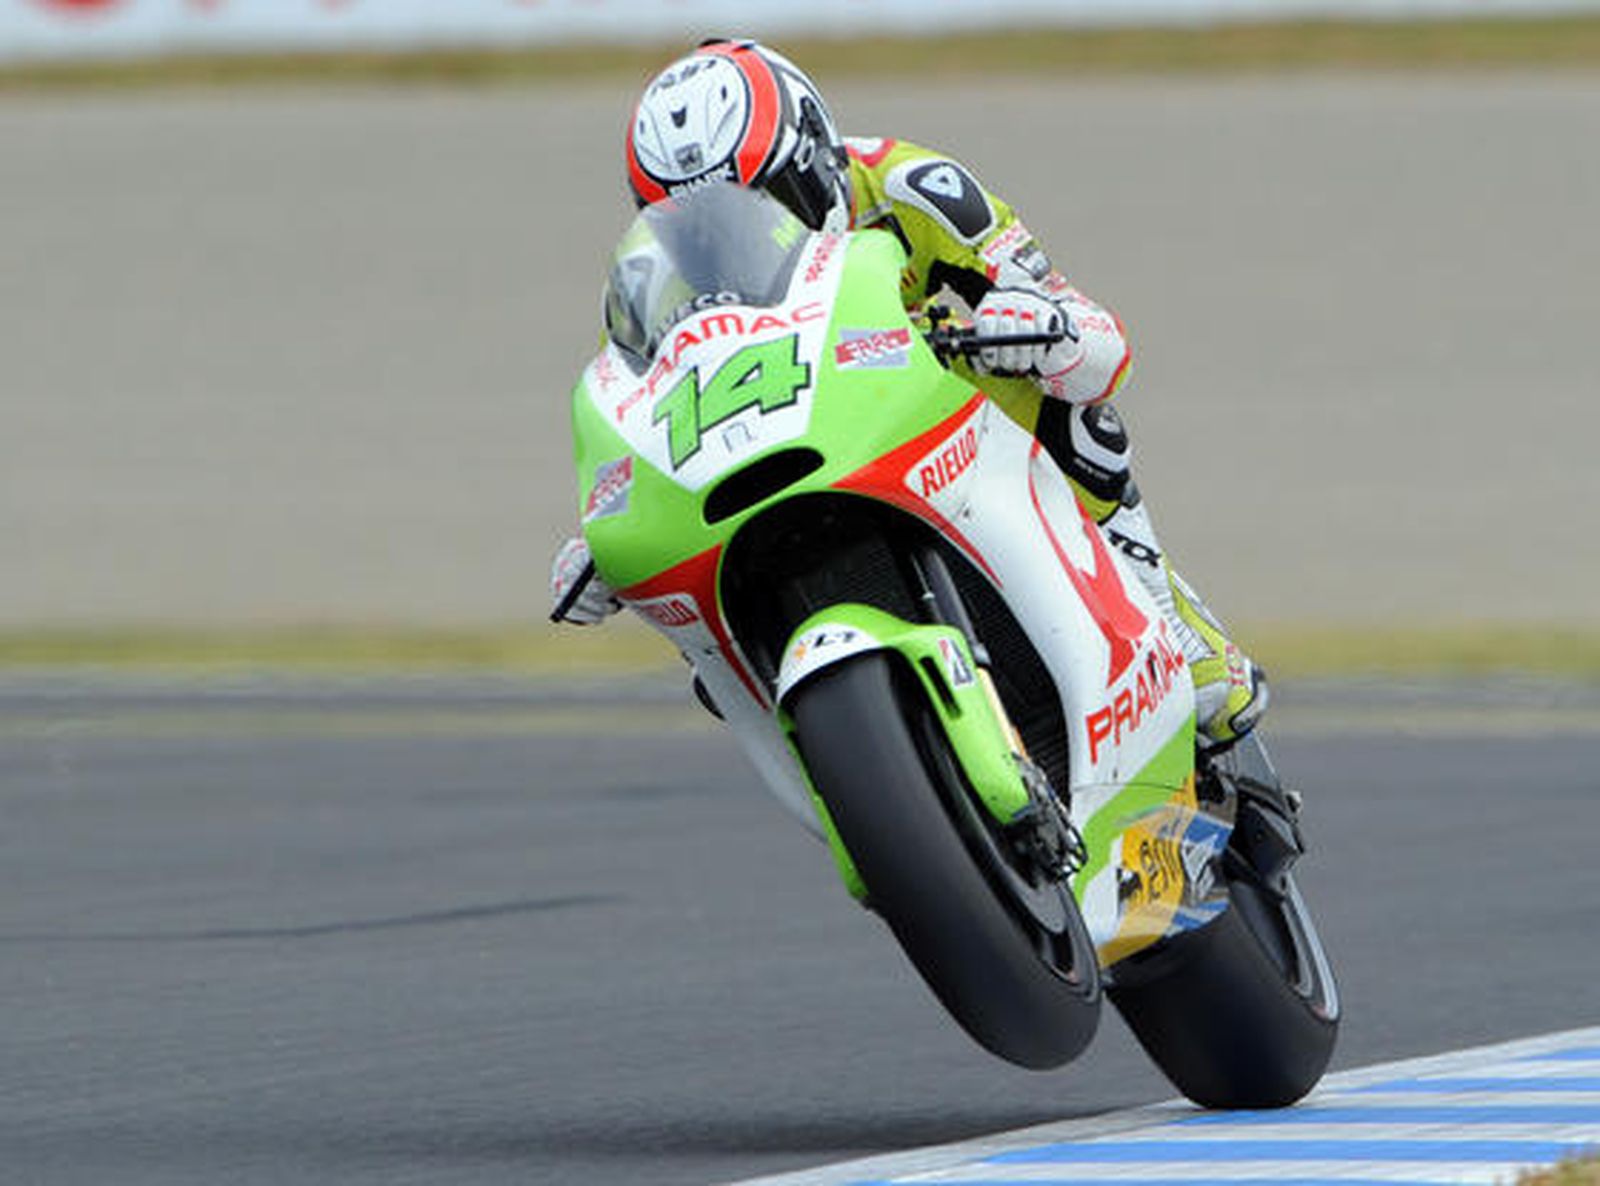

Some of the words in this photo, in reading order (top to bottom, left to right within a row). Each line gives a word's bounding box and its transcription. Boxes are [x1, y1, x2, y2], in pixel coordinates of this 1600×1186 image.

[616, 303, 826, 421] PRAMAC
[652, 333, 811, 471] 14
[920, 427, 977, 497] RIELLO
